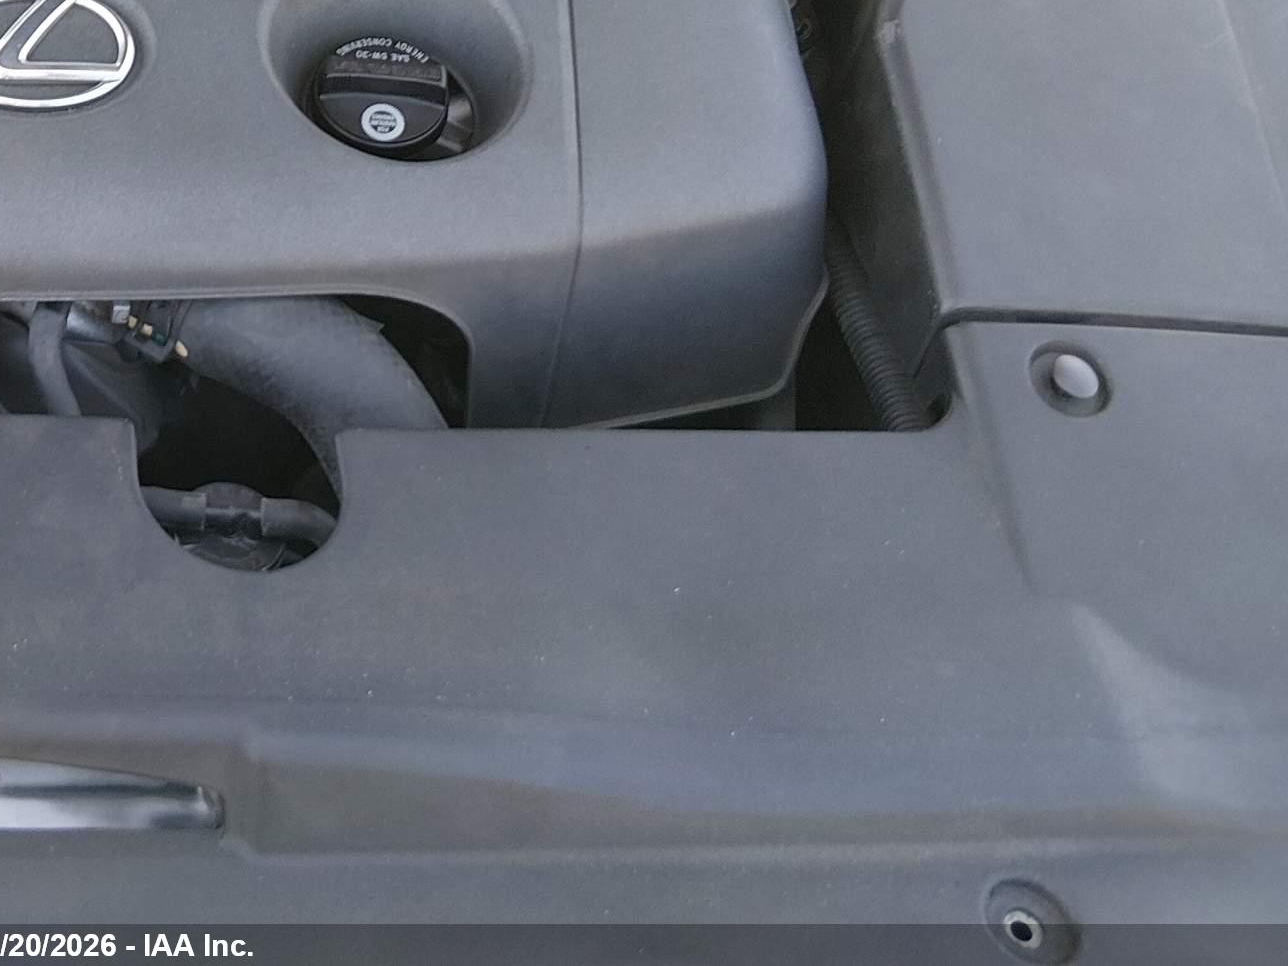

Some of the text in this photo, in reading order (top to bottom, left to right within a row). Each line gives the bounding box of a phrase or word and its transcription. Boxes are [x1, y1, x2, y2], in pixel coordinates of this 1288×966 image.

[335, 37, 430, 63] ENERGY CONSERVING
[392, 52, 410, 62] SAE
